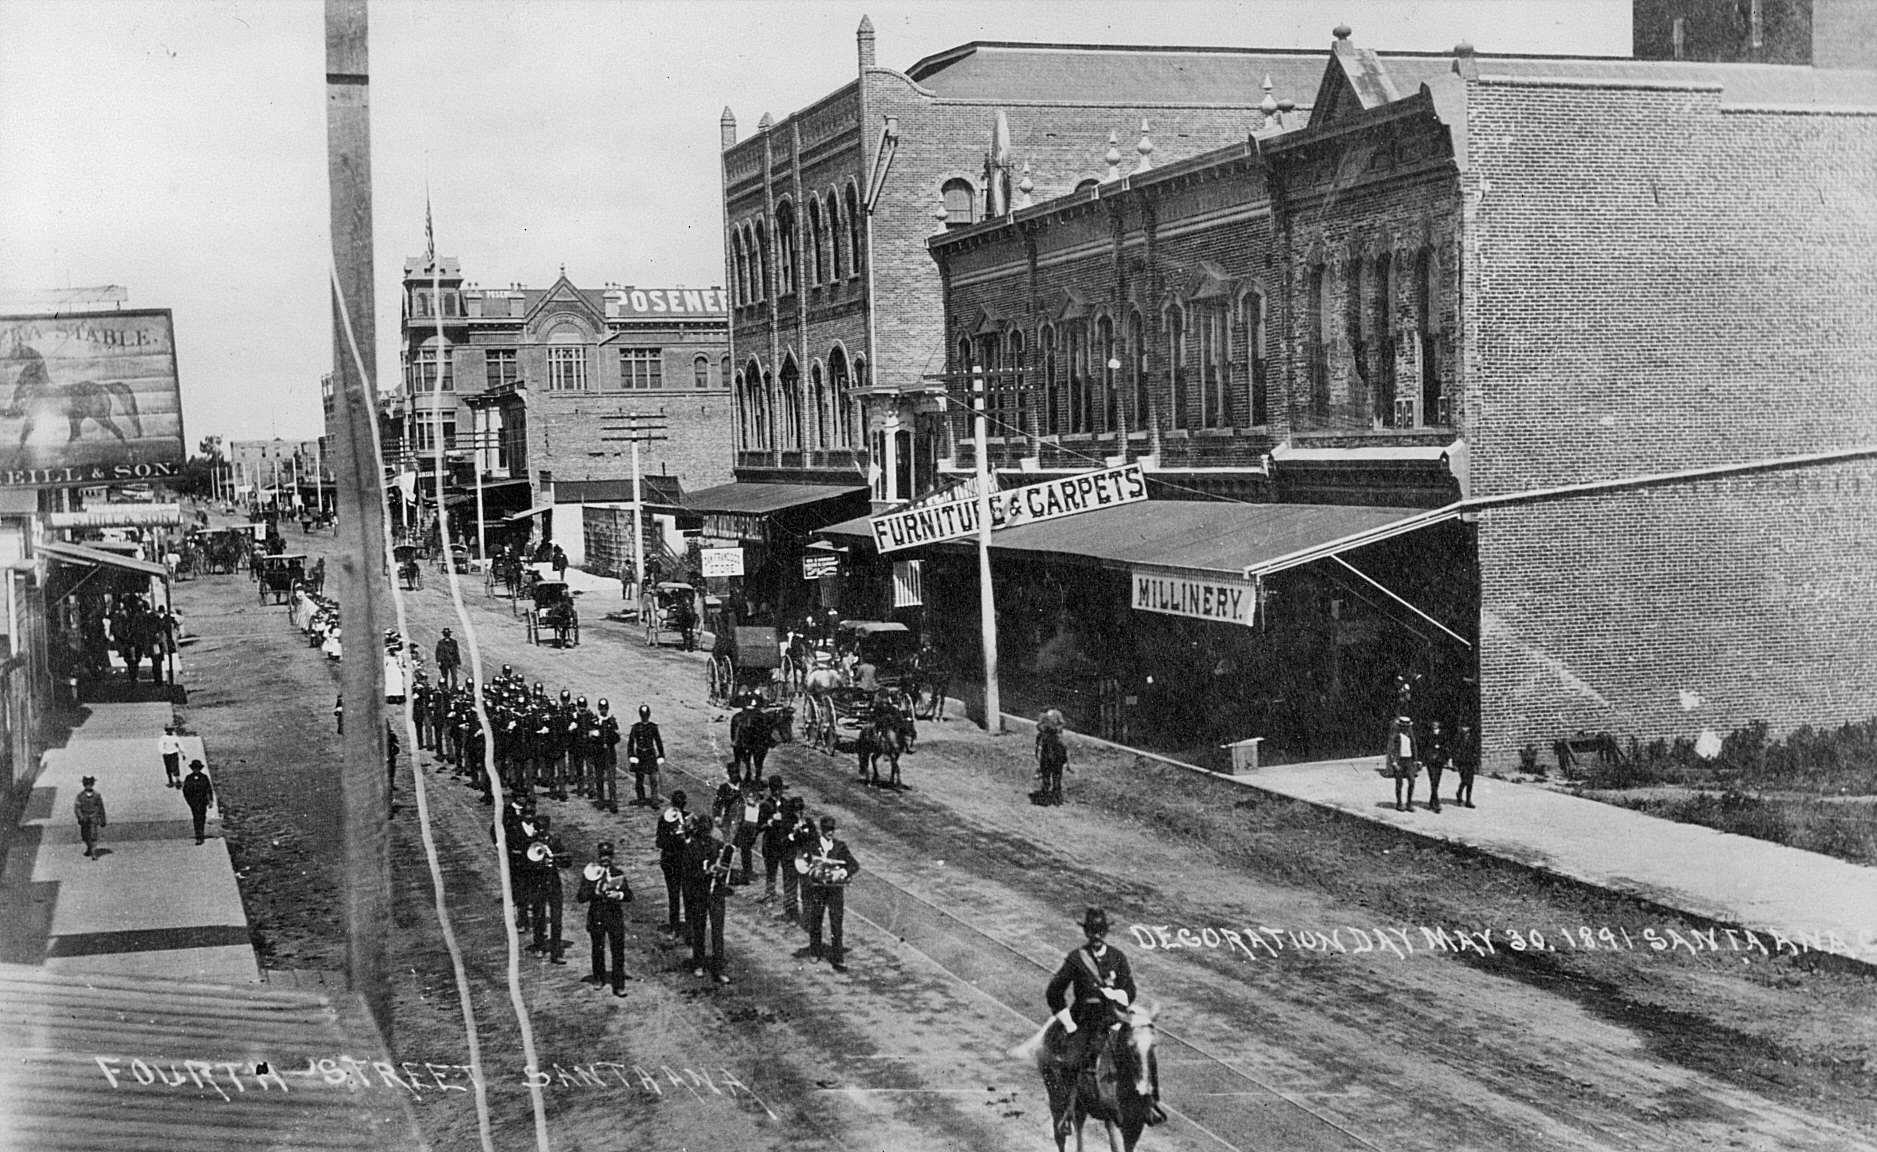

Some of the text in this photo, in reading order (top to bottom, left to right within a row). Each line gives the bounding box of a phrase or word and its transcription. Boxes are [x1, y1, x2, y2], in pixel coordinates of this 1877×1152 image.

[0, 467, 83, 485] EILL
[91, 467, 105, 480] &
[1009, 496, 1022, 517] &
[1026, 467, 1146, 519] CARPETS
[1138, 577, 1243, 620] MILLINERY.
